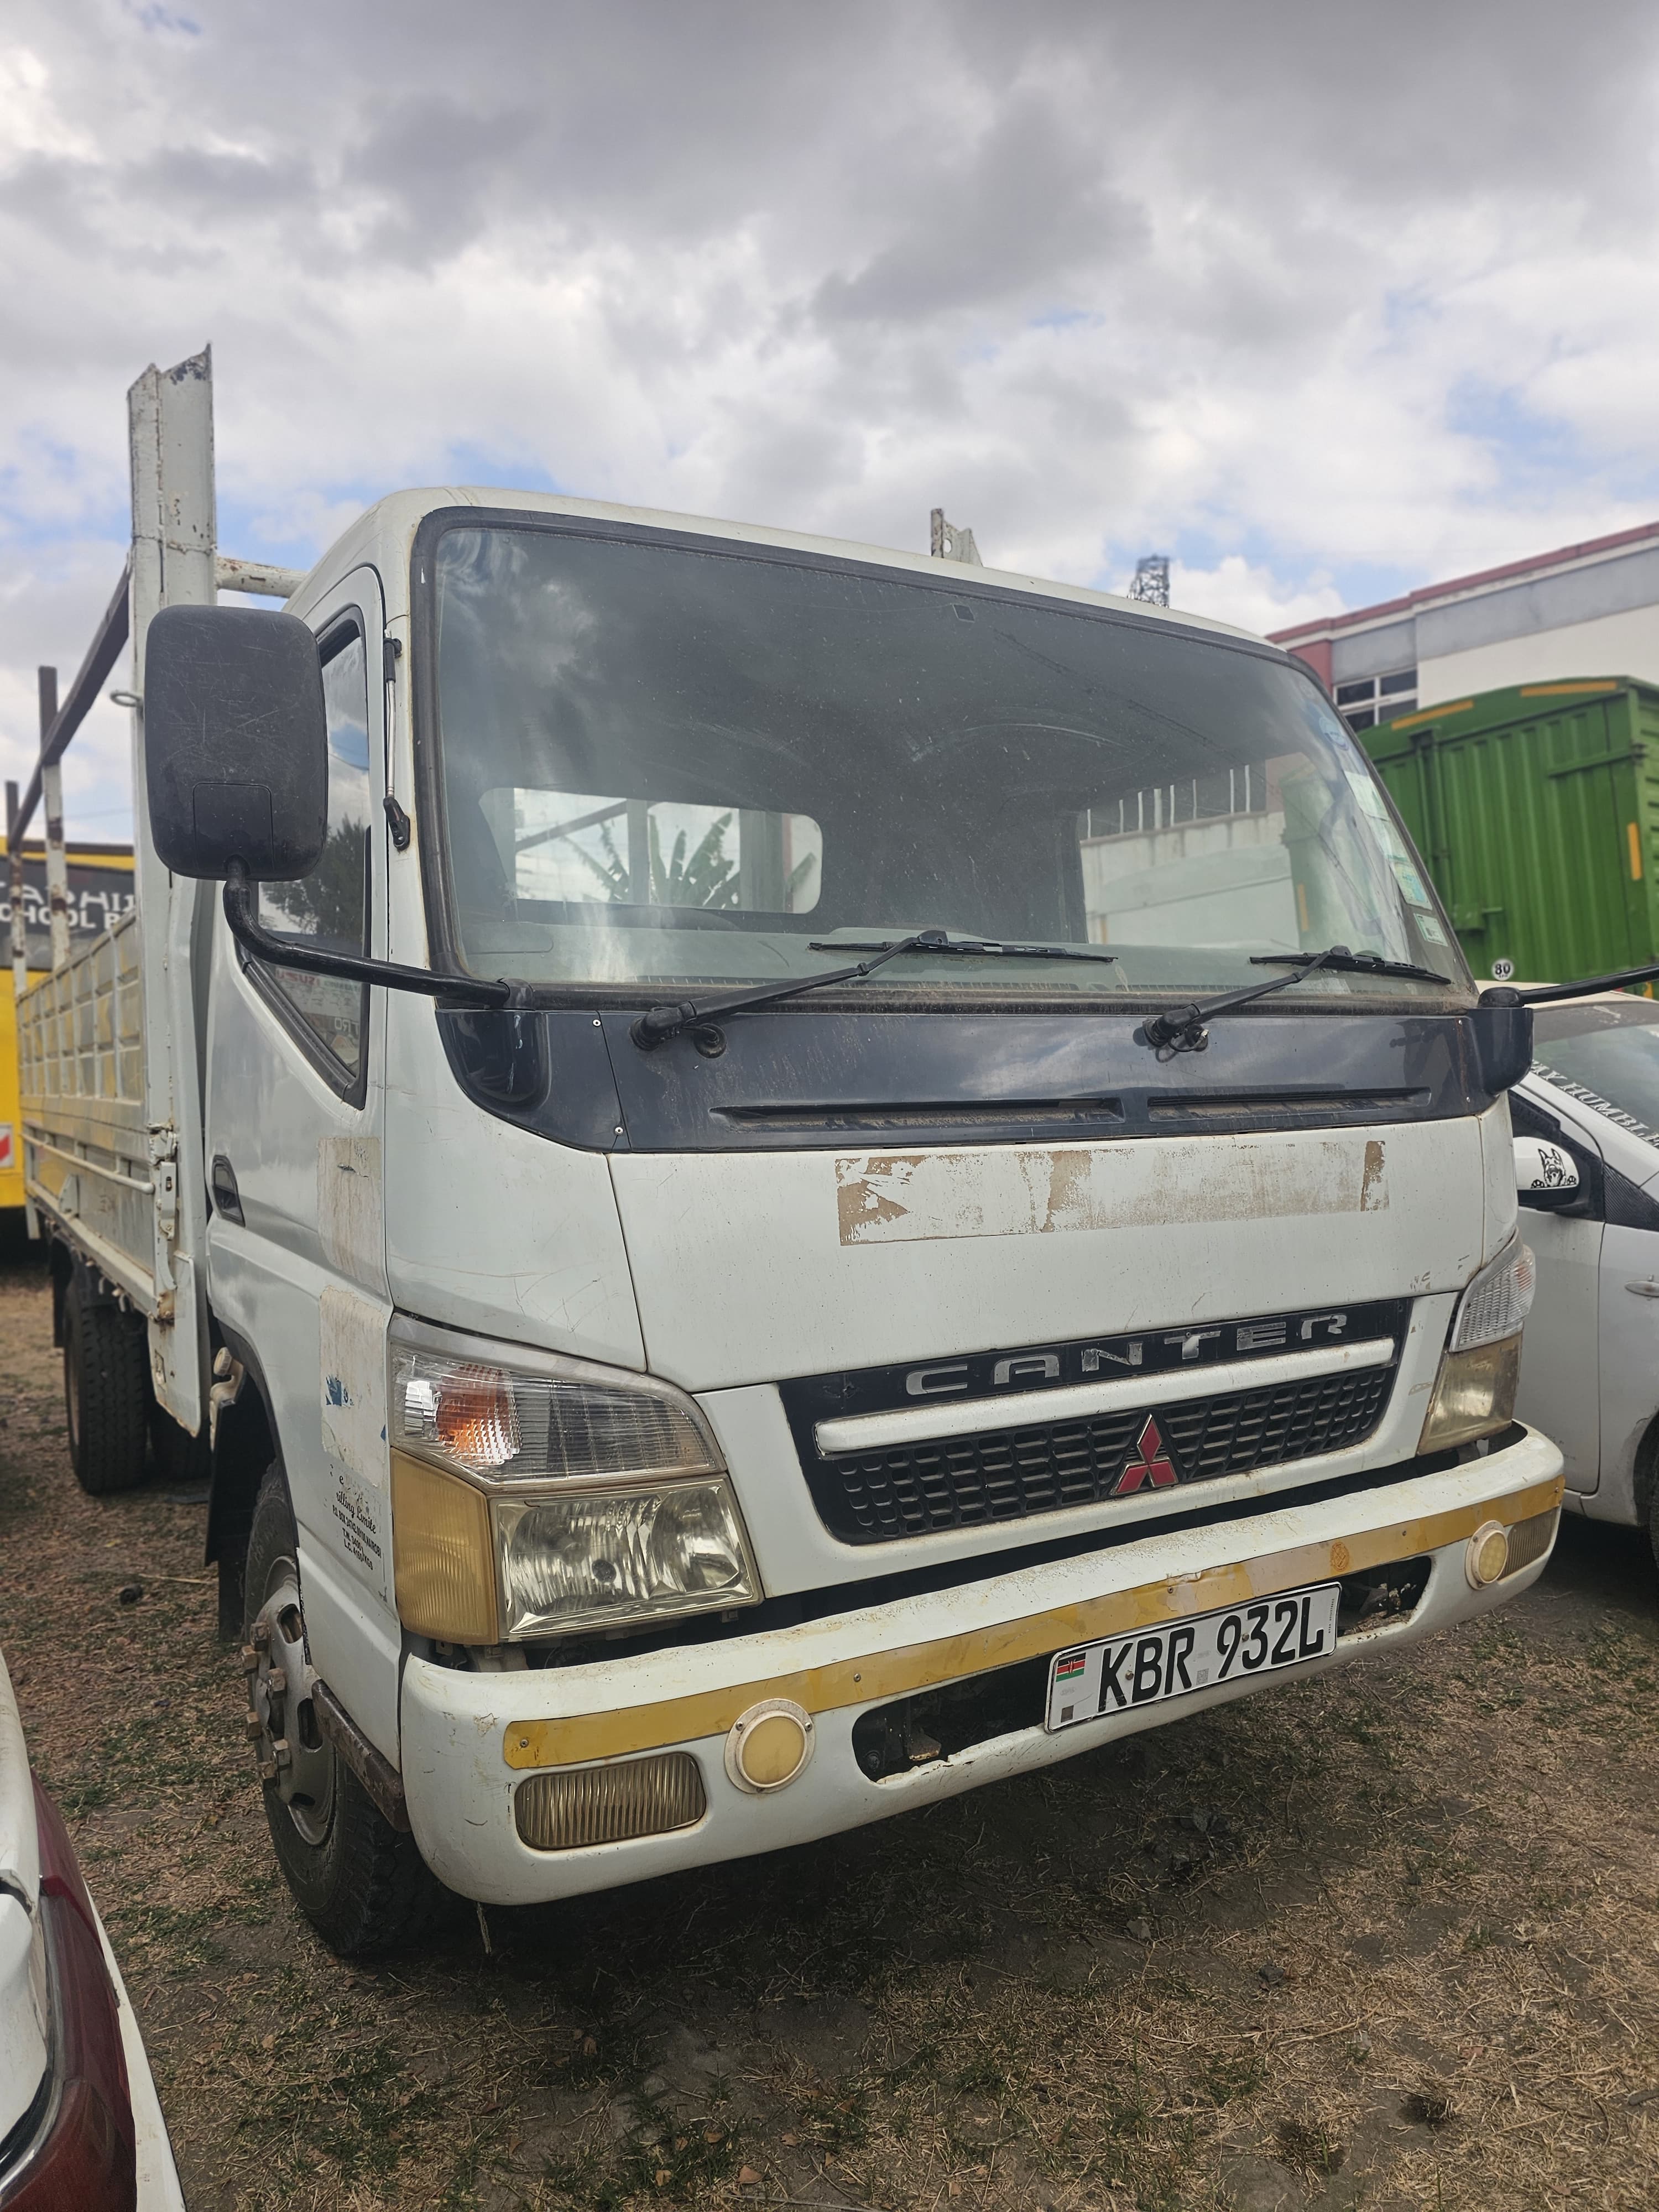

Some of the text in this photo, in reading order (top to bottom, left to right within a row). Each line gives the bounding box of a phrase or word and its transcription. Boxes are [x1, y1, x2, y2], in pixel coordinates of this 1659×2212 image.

[1495, 963, 1511, 975] 80
[905, 1313, 1348, 1397] CANTER
[1097, 1626, 1196, 1713] KBR
[1216, 1596, 1324, 1679] 932L
